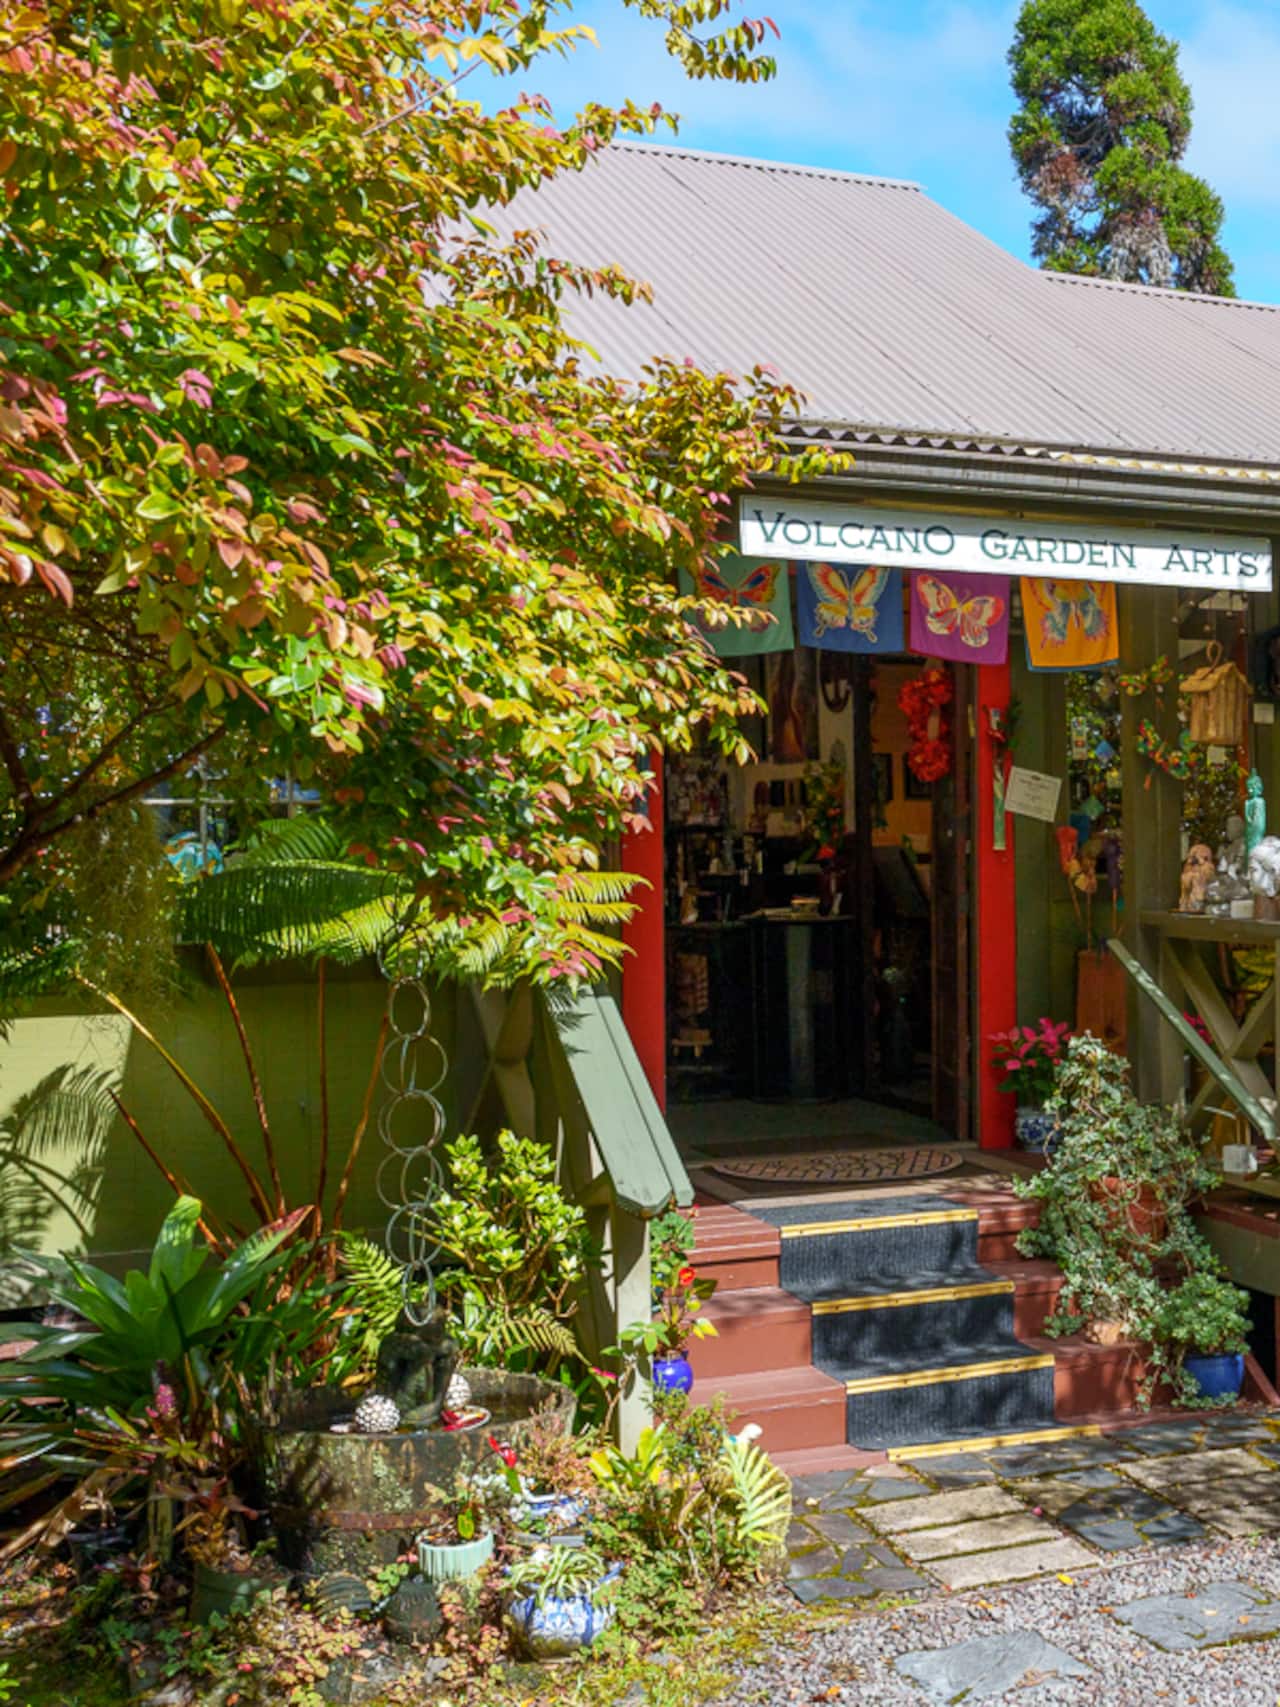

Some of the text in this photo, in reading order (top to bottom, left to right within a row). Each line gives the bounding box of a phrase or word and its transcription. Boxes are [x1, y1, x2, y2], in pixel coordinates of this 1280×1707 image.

[753, 509, 1259, 577] VOLCANO GARDEN ARTS
